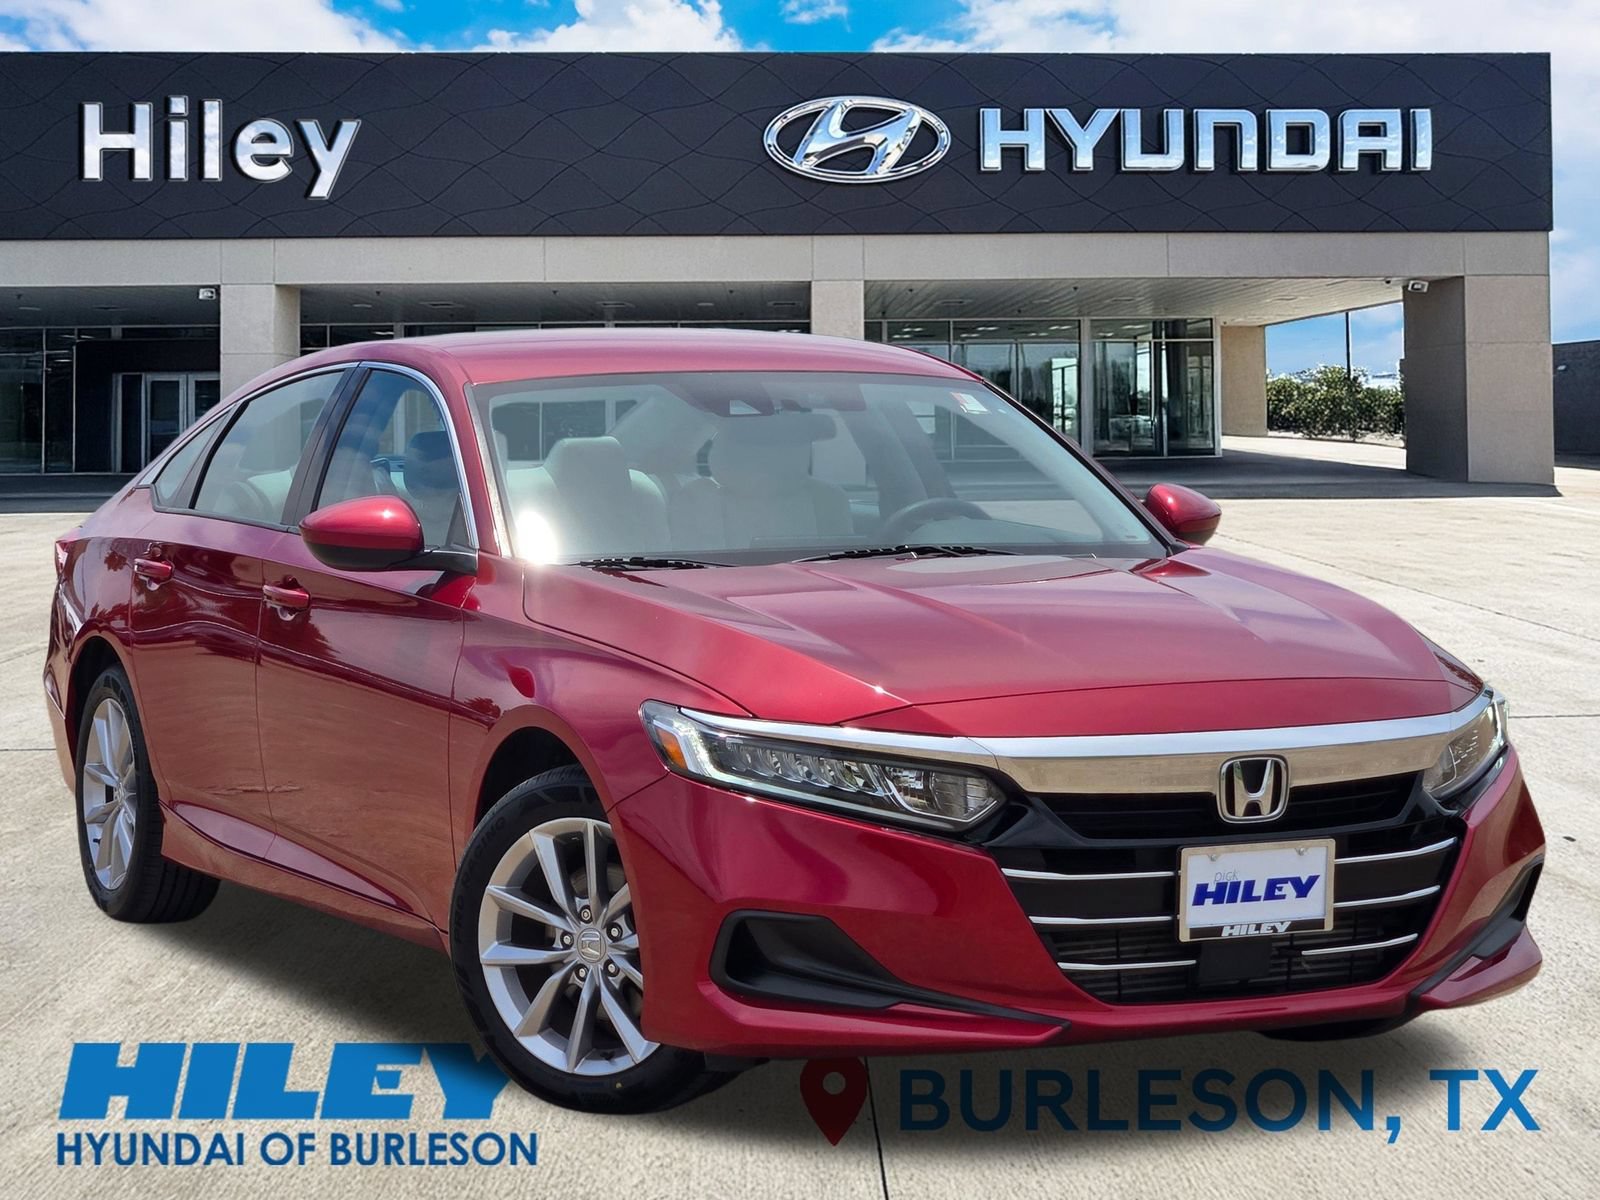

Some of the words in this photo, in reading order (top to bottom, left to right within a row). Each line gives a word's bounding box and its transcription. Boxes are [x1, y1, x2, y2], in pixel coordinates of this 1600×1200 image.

[80, 95, 362, 200] Hiley
[980, 108, 1433, 172] HYUNDAI
[1192, 874, 1321, 907] HILEY
[1221, 921, 1291, 937] HILEY
